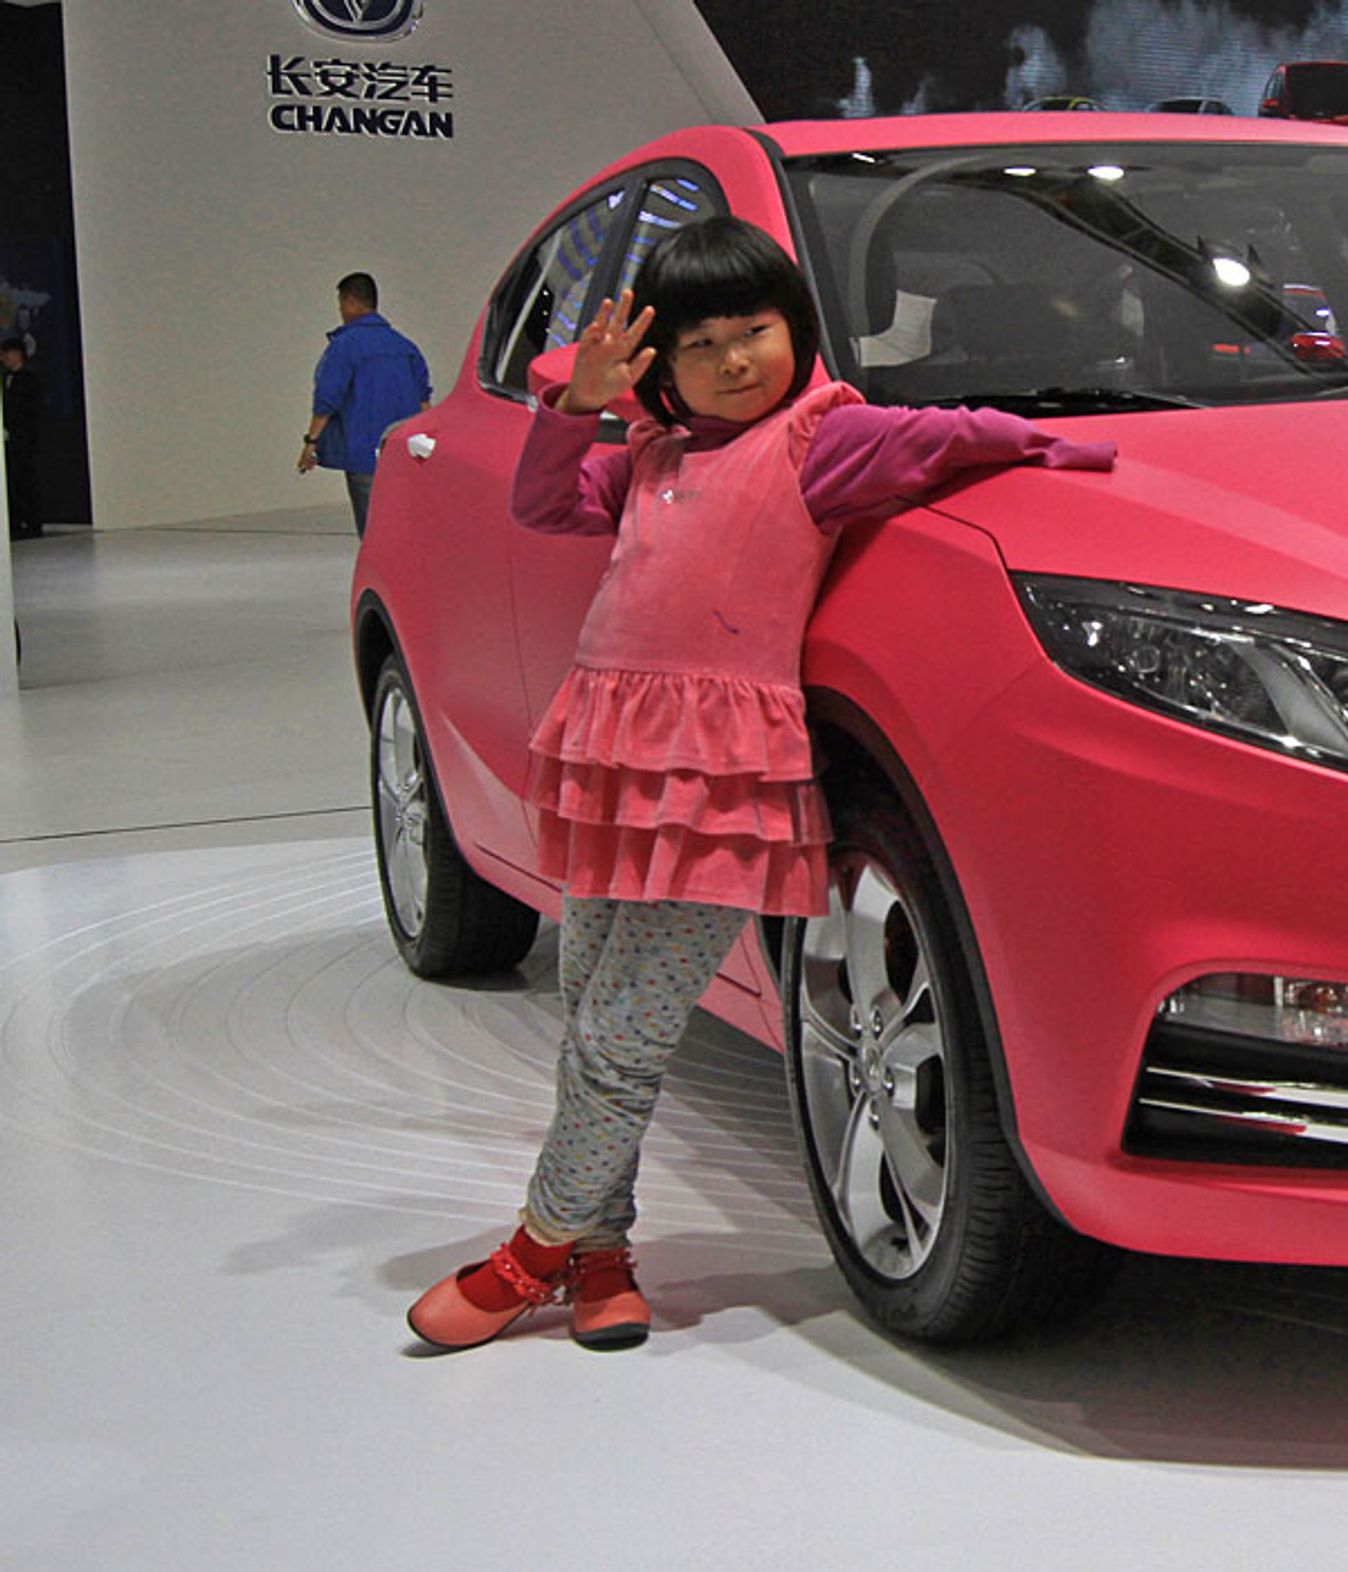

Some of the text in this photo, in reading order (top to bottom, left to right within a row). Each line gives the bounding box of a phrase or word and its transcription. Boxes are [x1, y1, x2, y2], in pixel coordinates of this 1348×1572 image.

[267, 55, 453, 102] 长安汽车
[270, 104, 453, 138] CHANGAN
